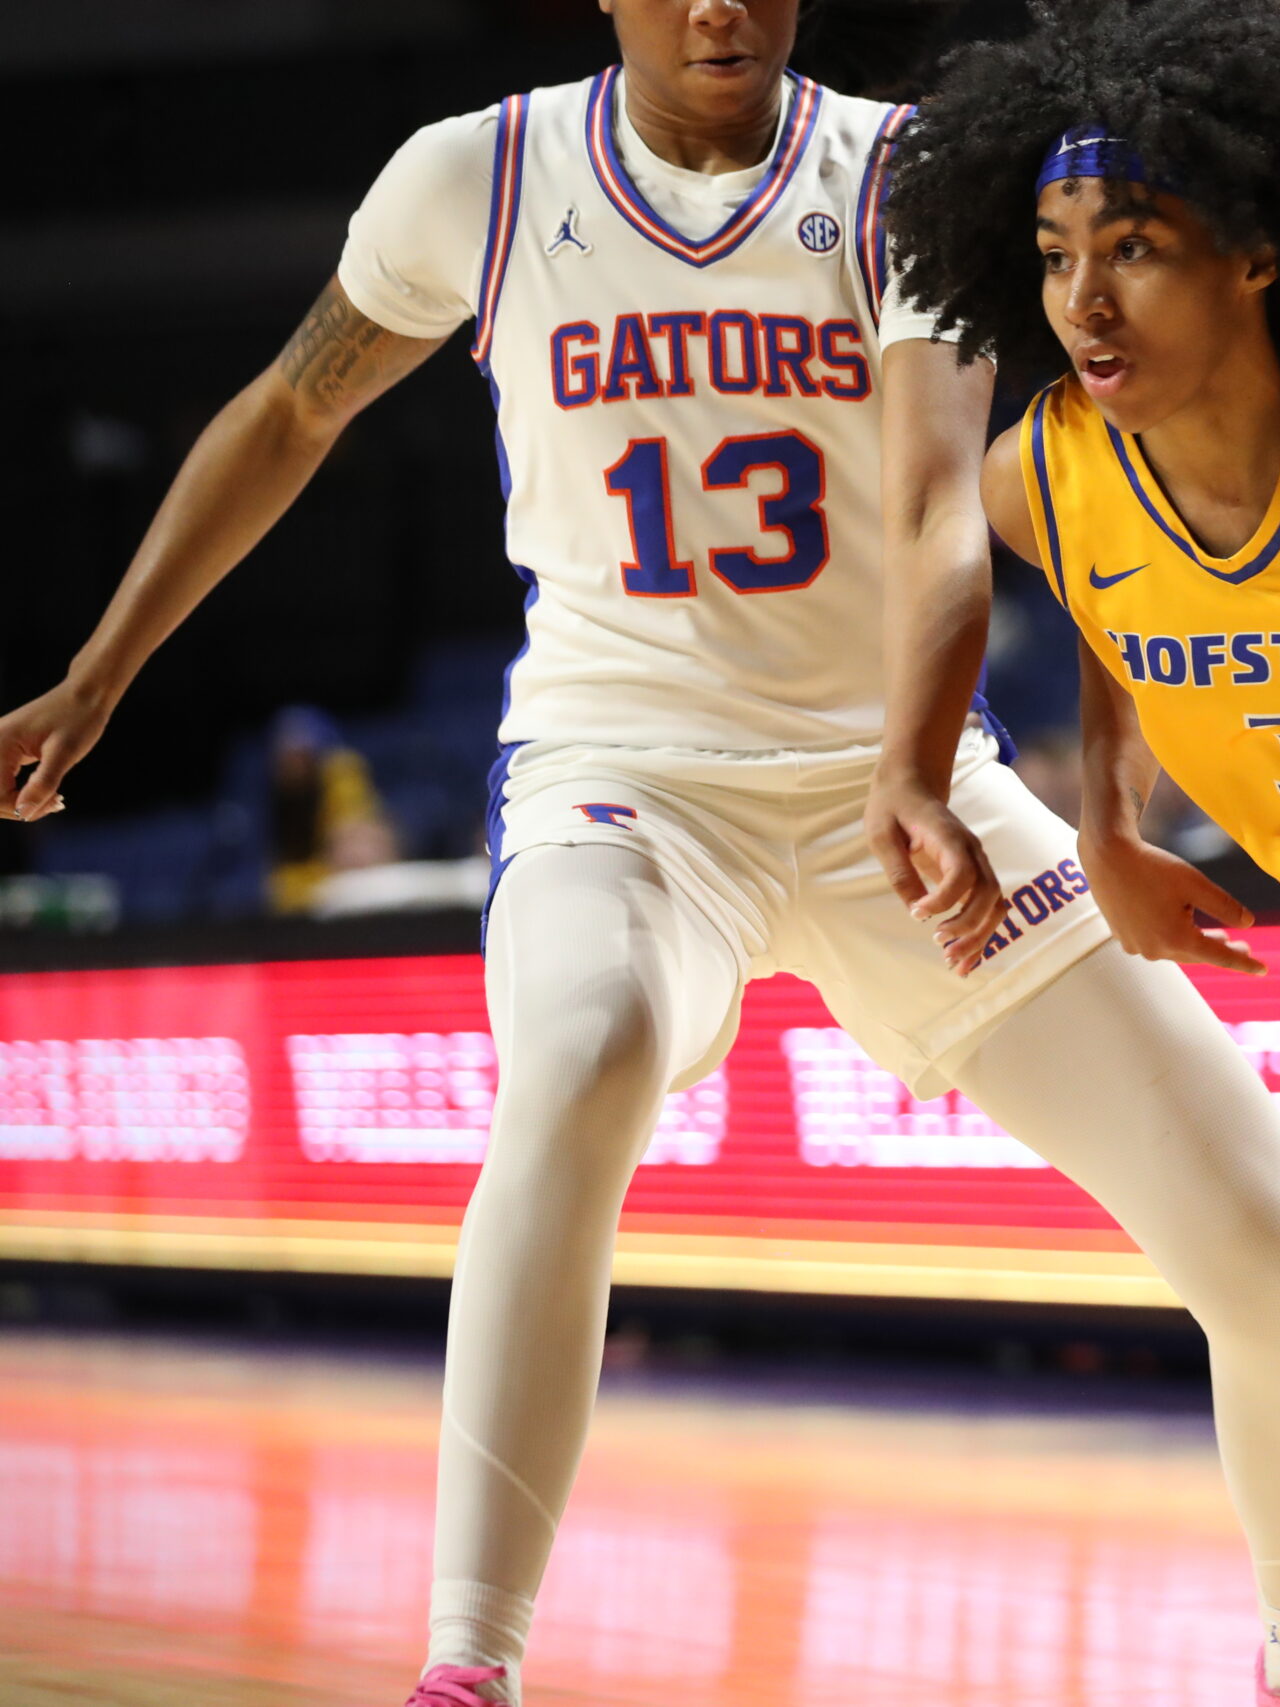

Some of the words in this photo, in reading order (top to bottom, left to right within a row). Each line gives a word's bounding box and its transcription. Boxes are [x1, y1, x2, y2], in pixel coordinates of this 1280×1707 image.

[800, 212, 837, 251] SEC
[550, 309, 871, 411] GATORS
[604, 428, 830, 598] 13
